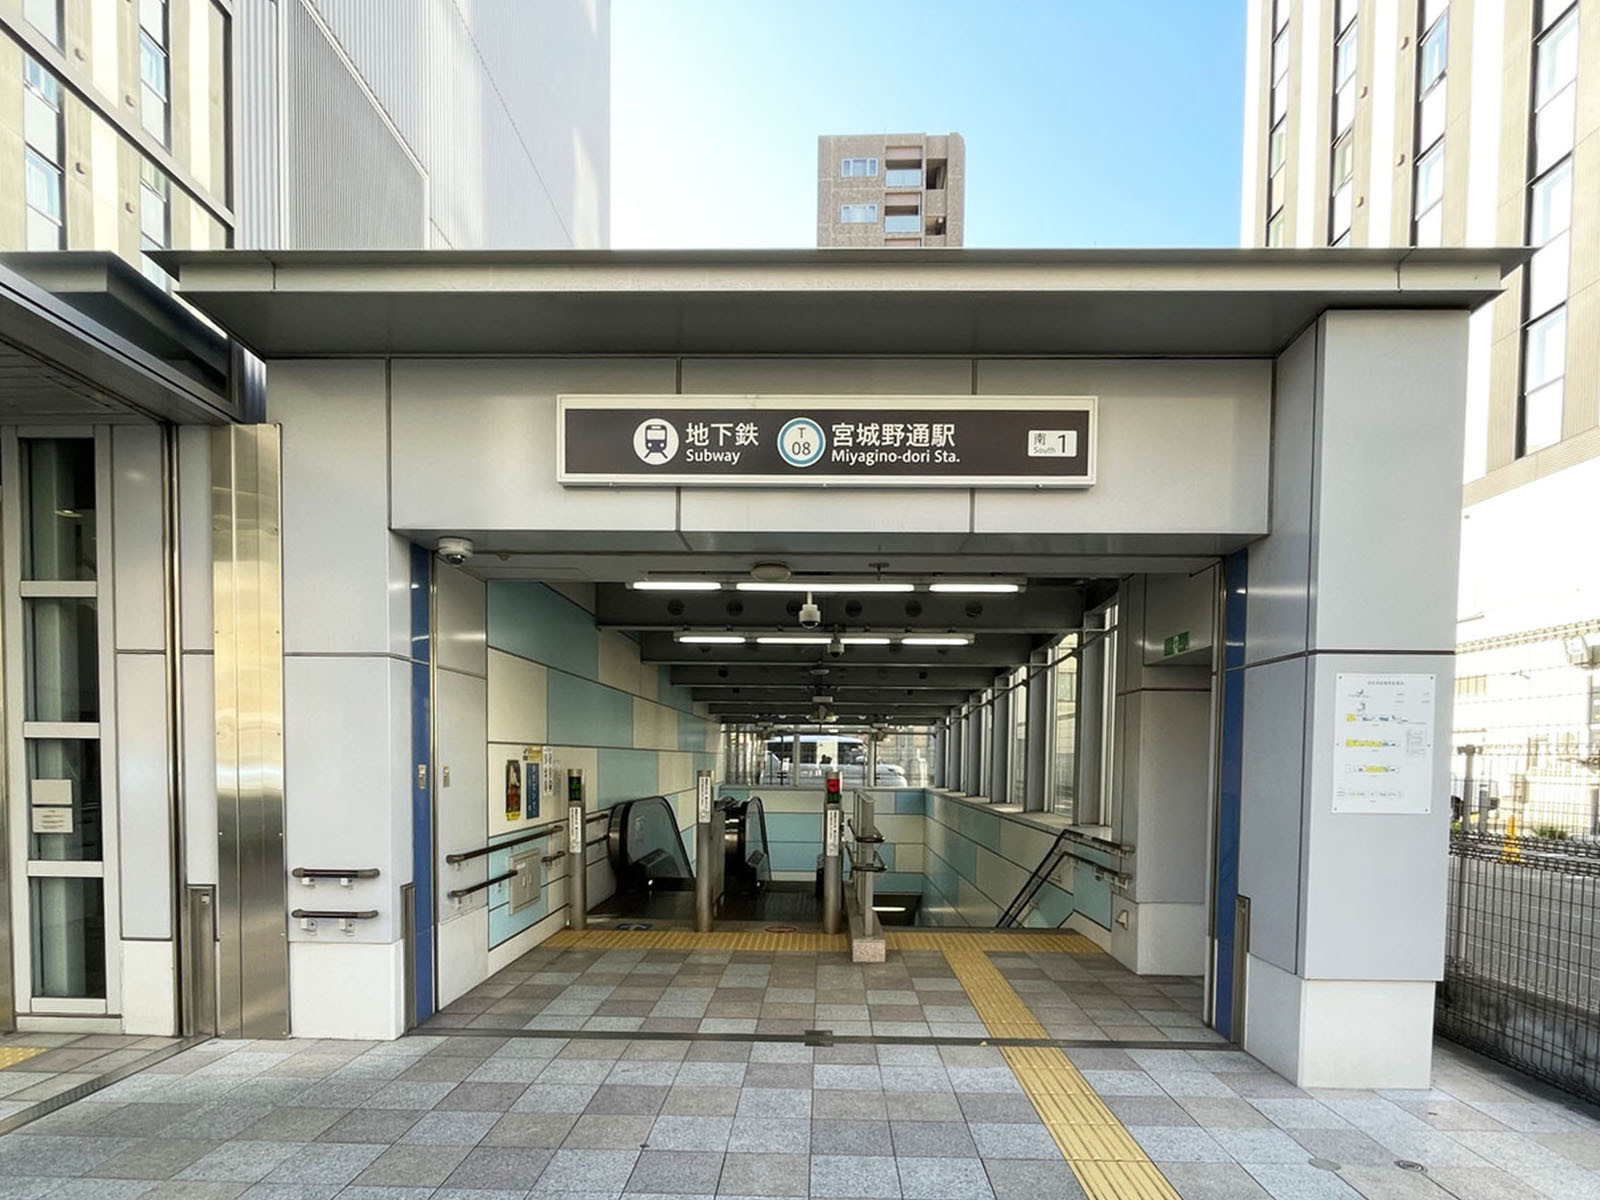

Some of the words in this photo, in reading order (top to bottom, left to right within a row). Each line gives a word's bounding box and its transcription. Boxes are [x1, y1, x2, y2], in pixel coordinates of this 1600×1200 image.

[685, 422, 759, 447] 地下鉄
[797, 427, 805, 439] T
[831, 422, 956, 448] 宮城野通駅
[1034, 432, 1046, 446] 南
[791, 441, 812, 456] 08
[1057, 434, 1066, 454] 1
[685, 448, 740, 465] Subway
[831, 449, 930, 466] Miyagino-dori
[934, 449, 960, 463] Sta.
